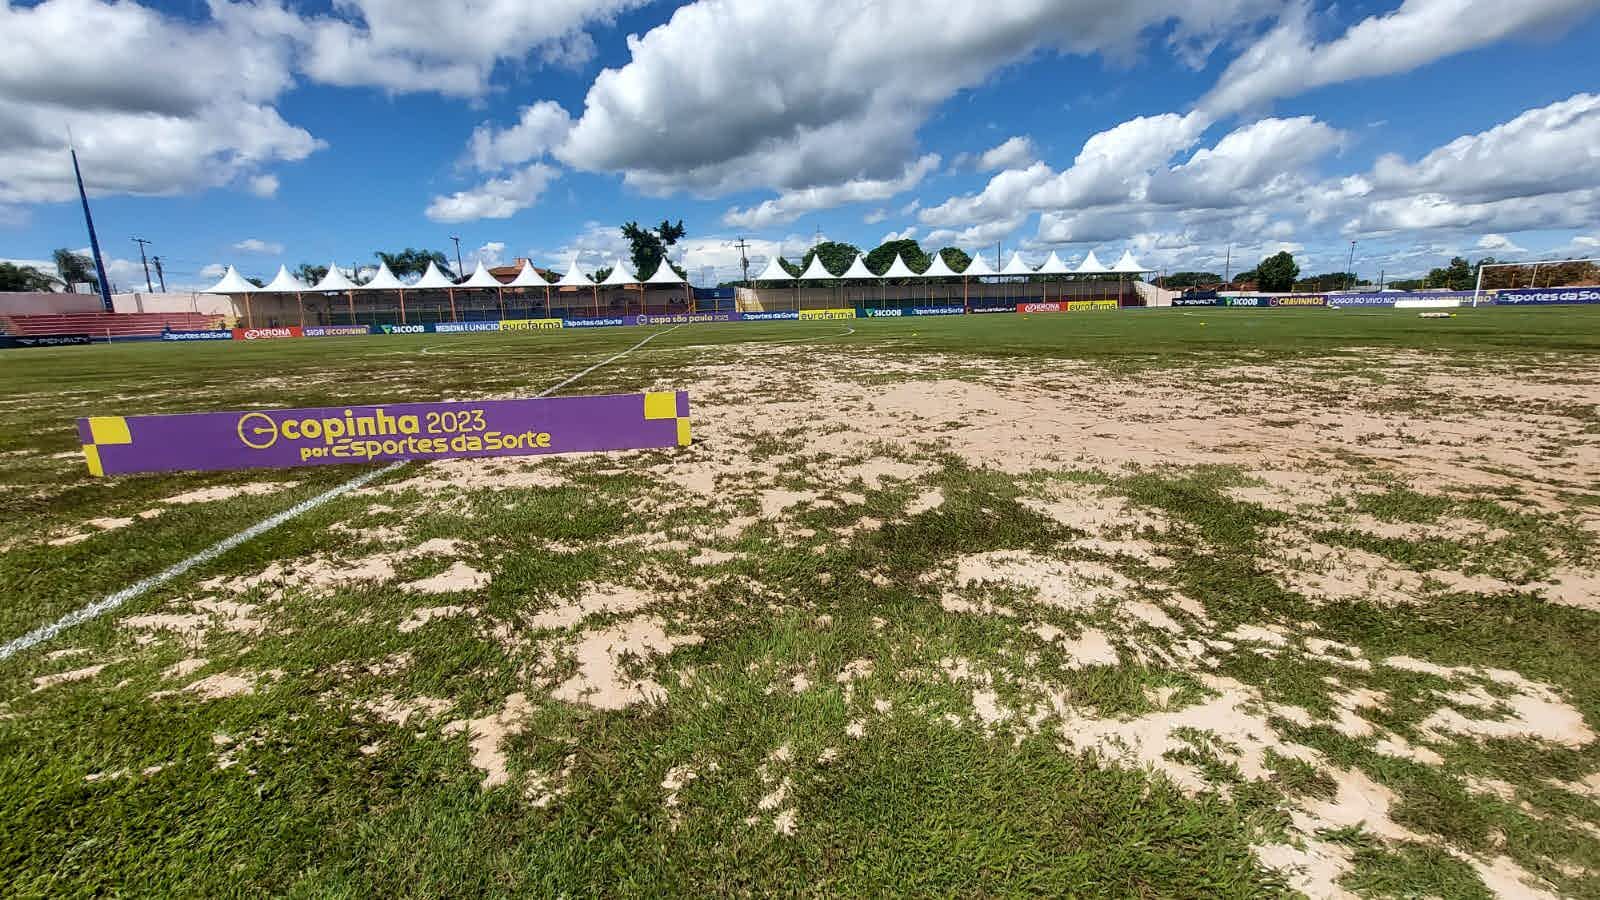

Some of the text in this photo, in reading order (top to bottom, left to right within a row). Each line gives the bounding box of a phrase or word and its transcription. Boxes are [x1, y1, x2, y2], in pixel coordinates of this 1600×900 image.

[1559, 292, 1577, 301] da
[1233, 298, 1258, 306] SICOOB
[1279, 297, 1324, 305] CRAVINHOS
[1331, 297, 1354, 305] JOGOS
[874, 309, 901, 317] SICOOB
[391, 325, 425, 333] SICOOB
[502, 321, 561, 331] eurofarma
[259, 328, 292, 337] KRONA
[281, 409, 487, 443] copinha 2023
[300, 430, 552, 461] por Esportes da Sorte
